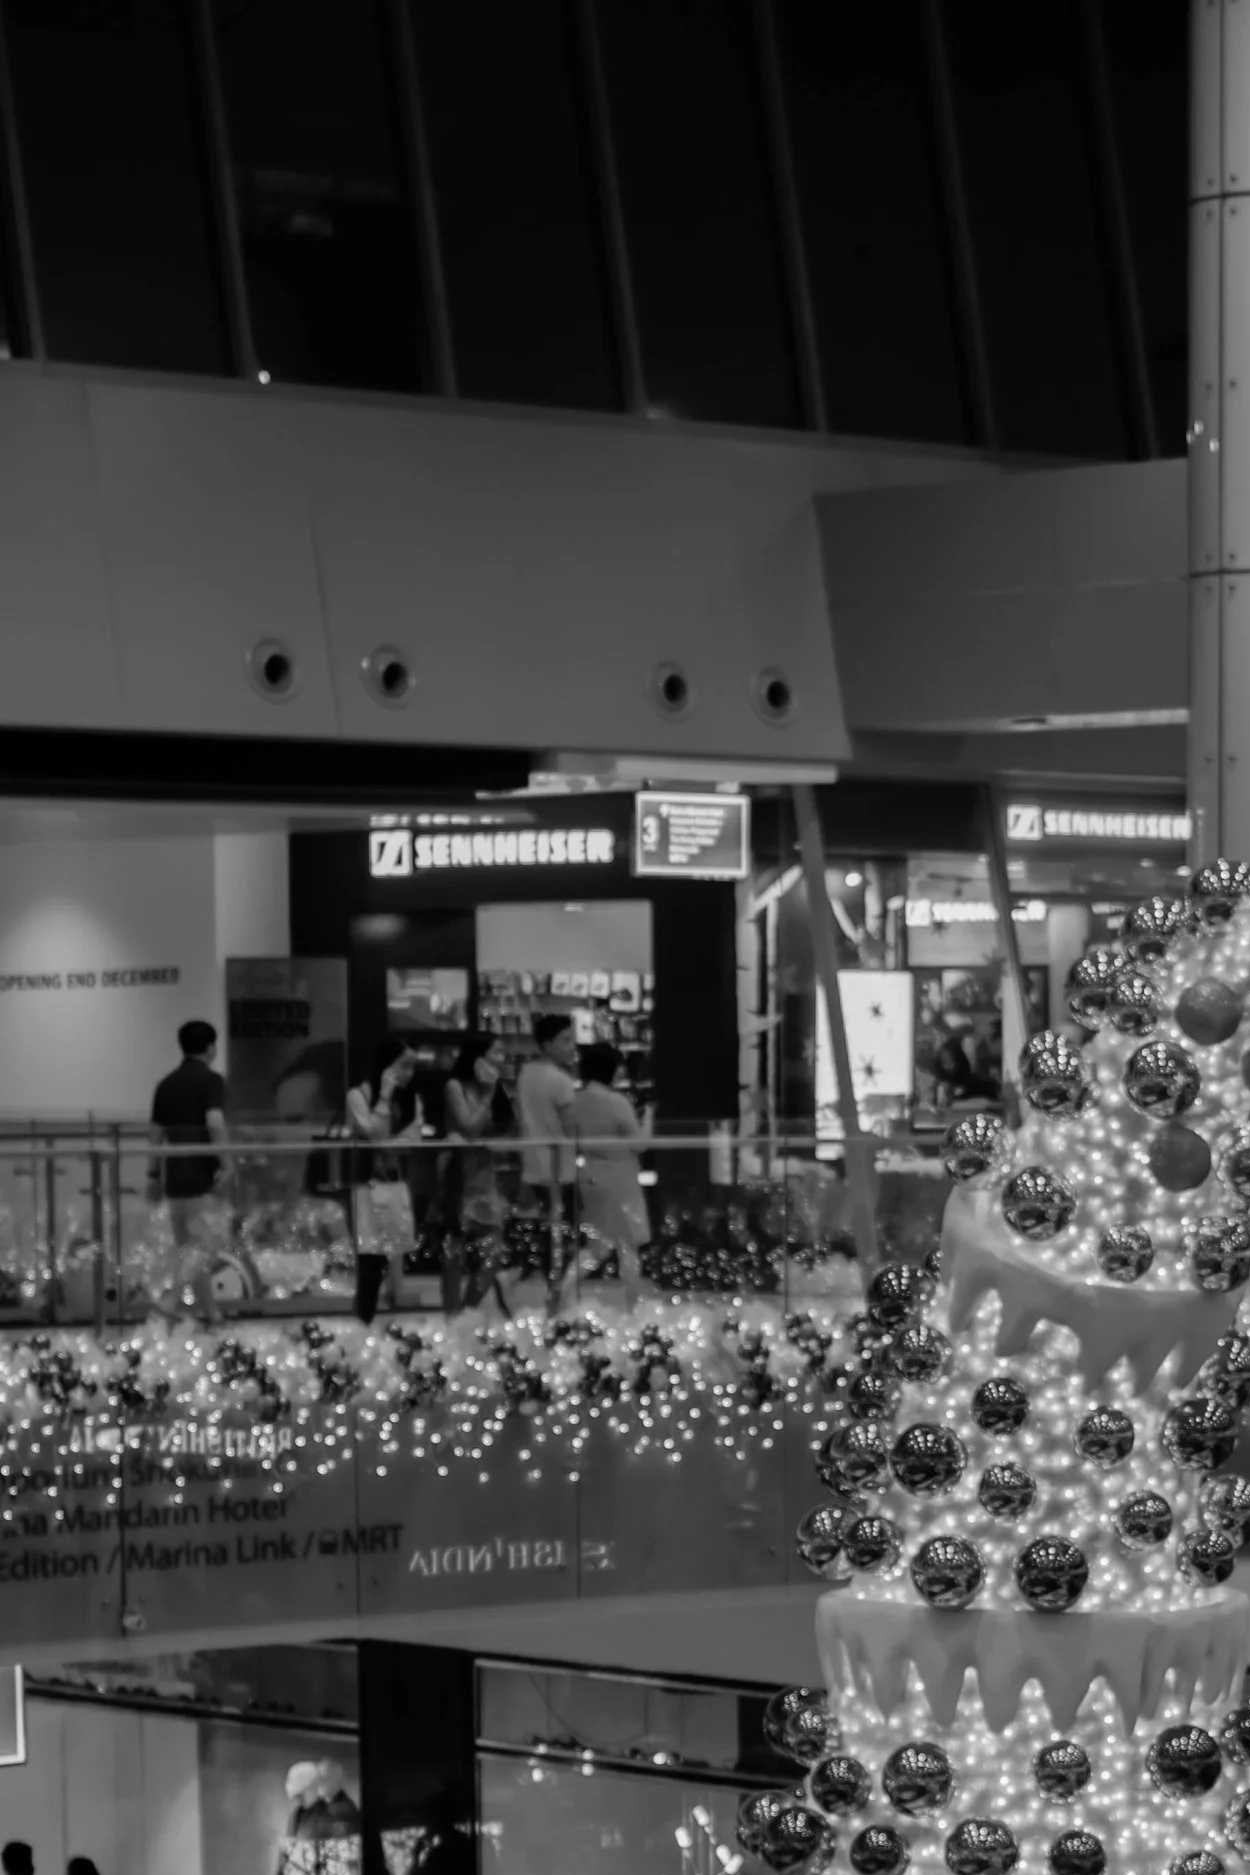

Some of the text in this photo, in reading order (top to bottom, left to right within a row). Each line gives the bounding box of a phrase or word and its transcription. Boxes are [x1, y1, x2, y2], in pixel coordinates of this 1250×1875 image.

[643, 816, 659, 843] 3
[1043, 810, 1193, 841] SENNHEISER
[414, 829, 614, 868] SENNHEISER
[66, 972, 96, 989] END
[101, 967, 180, 987] DECEMBER
[57, 1499, 200, 1534] Mandarin
[207, 1493, 287, 1523] Hotel
[127, 1539, 228, 1571] Marina
[236, 1531, 296, 1564] Link
[342, 1523, 404, 1555] MRT
